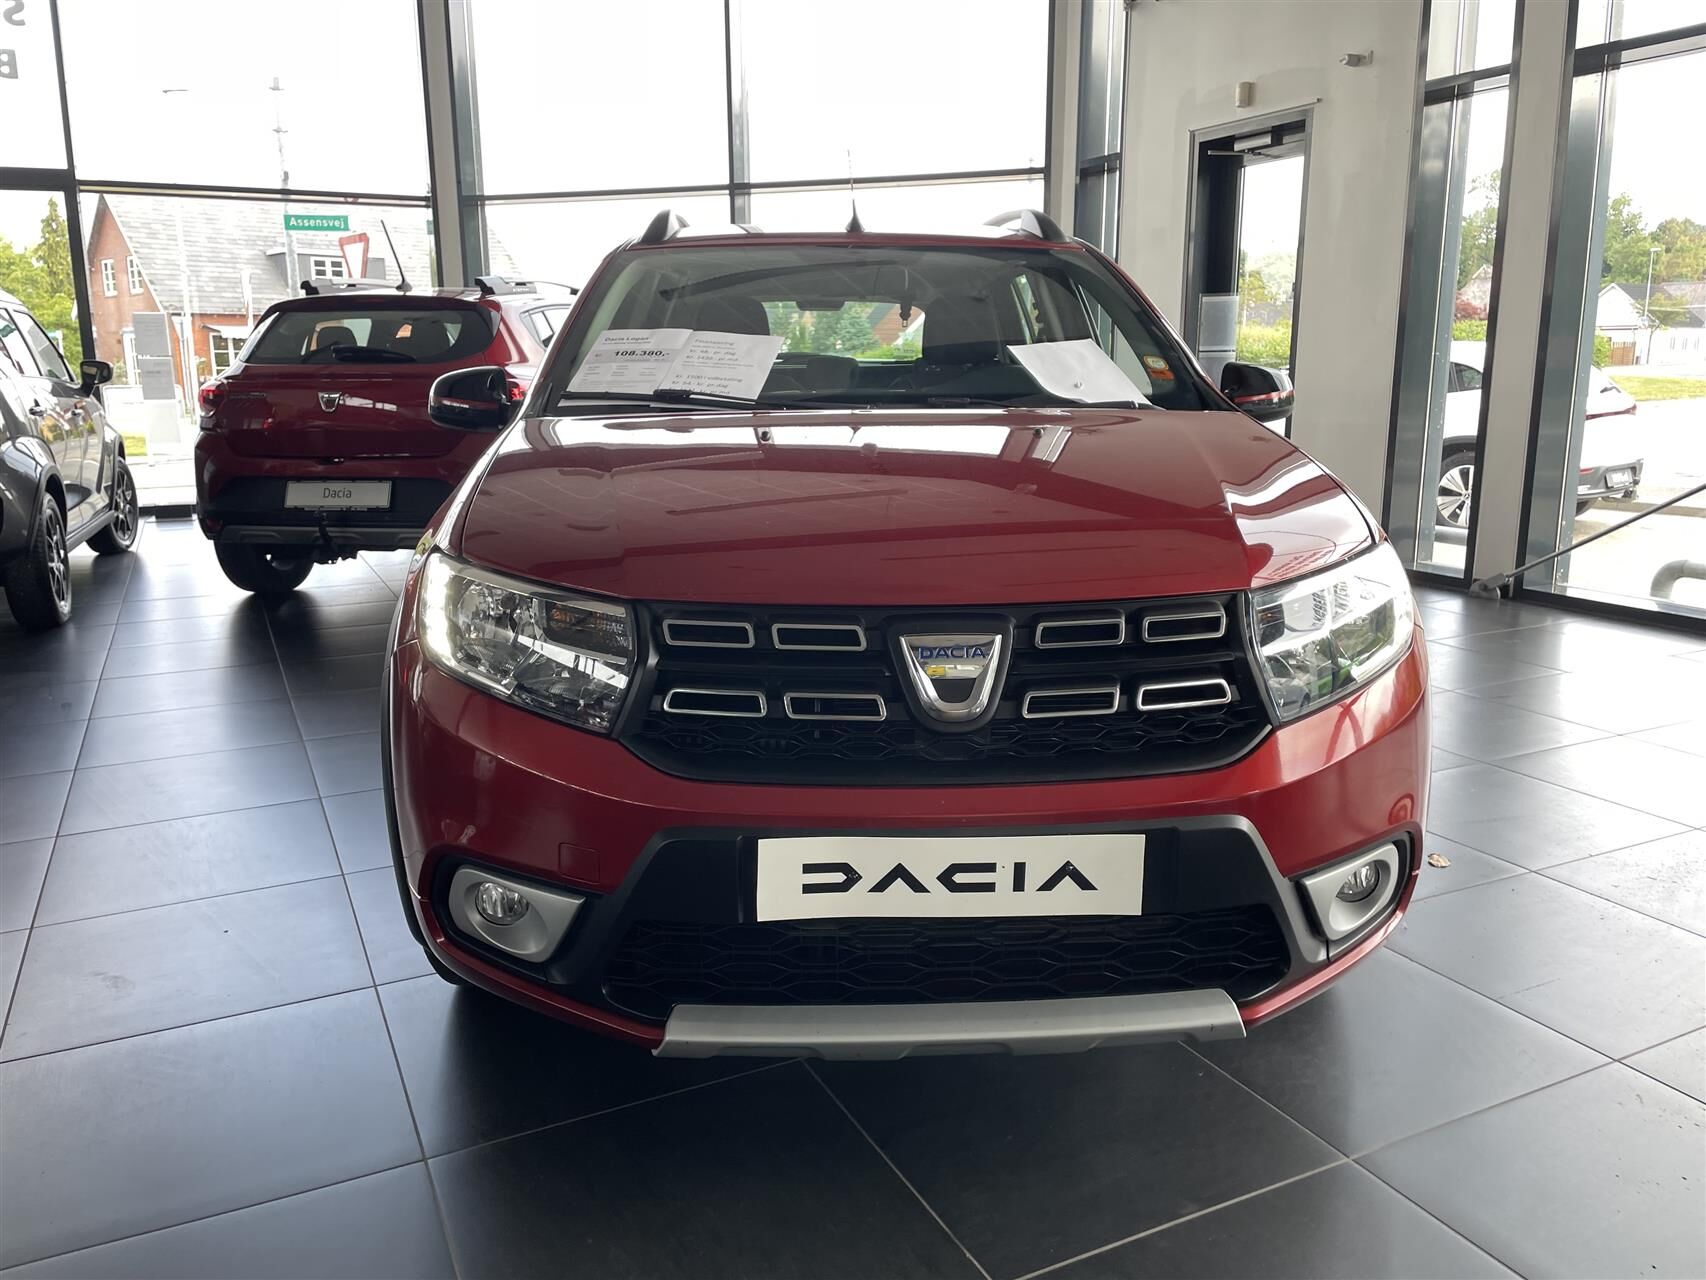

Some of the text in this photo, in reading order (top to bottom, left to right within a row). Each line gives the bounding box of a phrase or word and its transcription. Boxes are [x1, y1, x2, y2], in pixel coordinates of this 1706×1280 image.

[289, 217, 345, 229] Assensvej
[323, 487, 352, 499] Dacia
[919, 645, 987, 659] DACIA
[802, 860, 1098, 894] DACIA
